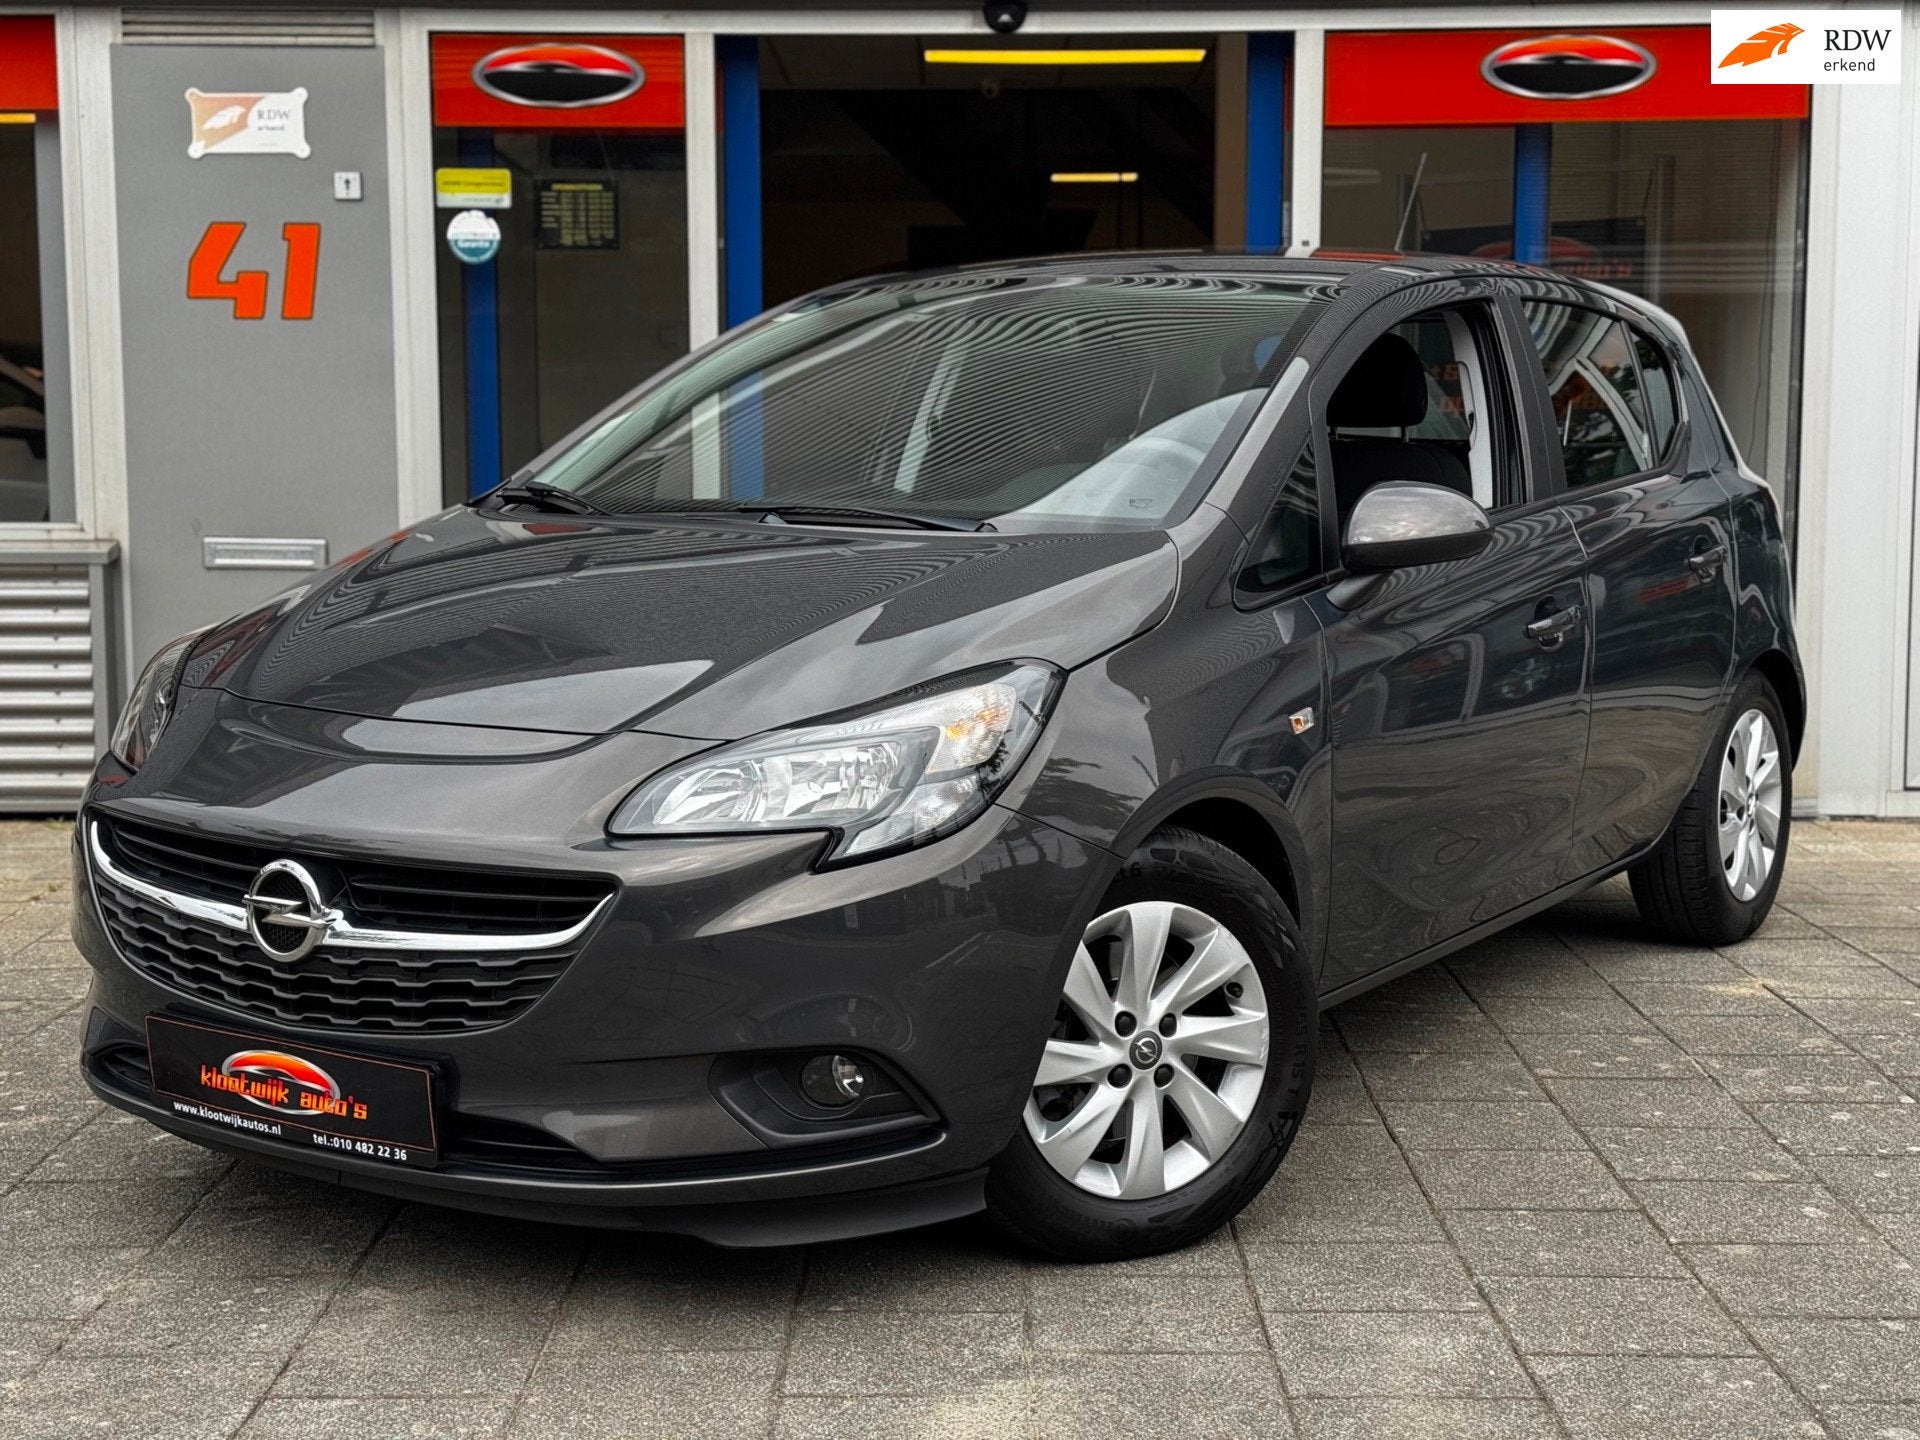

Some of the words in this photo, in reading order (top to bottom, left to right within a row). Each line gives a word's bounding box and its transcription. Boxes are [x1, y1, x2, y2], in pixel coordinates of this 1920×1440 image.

[256, 108, 291, 120] RDW
[187, 221, 321, 320] 41
[200, 1064, 290, 1107] klootwijk
[300, 1088, 368, 1120] auto's
[173, 1101, 282, 1135] www.klootwijkautos.nl
[313, 1133, 352, 1150] tel.:010
[354, 1141, 375, 1155] 482
[377, 1145, 391, 1158] 22
[394, 1148, 408, 1161] 36
